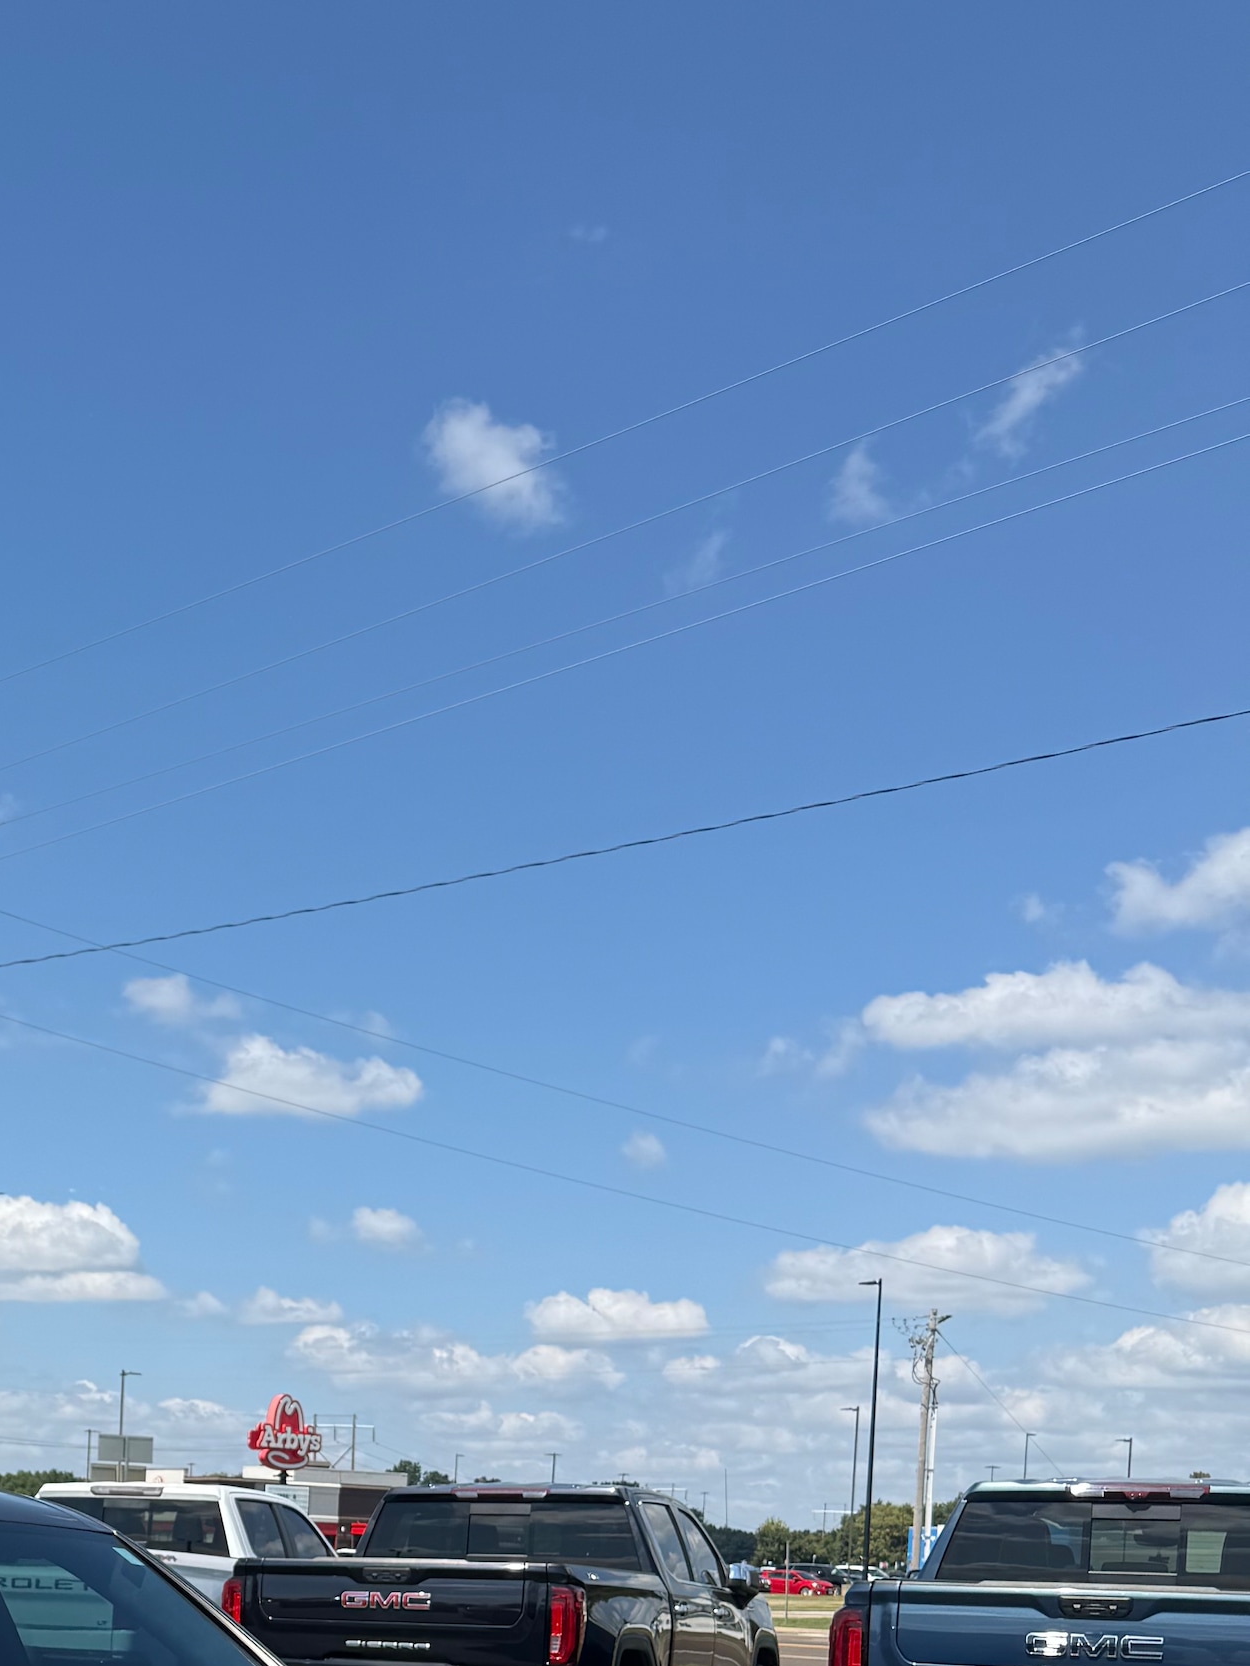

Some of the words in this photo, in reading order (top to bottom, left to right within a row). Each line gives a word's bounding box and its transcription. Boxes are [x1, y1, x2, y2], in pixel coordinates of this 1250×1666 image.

[260, 1424, 322, 1457] Arby's
[341, 1590, 431, 1611] GMC
[1025, 1631, 1164, 1660] GMC
